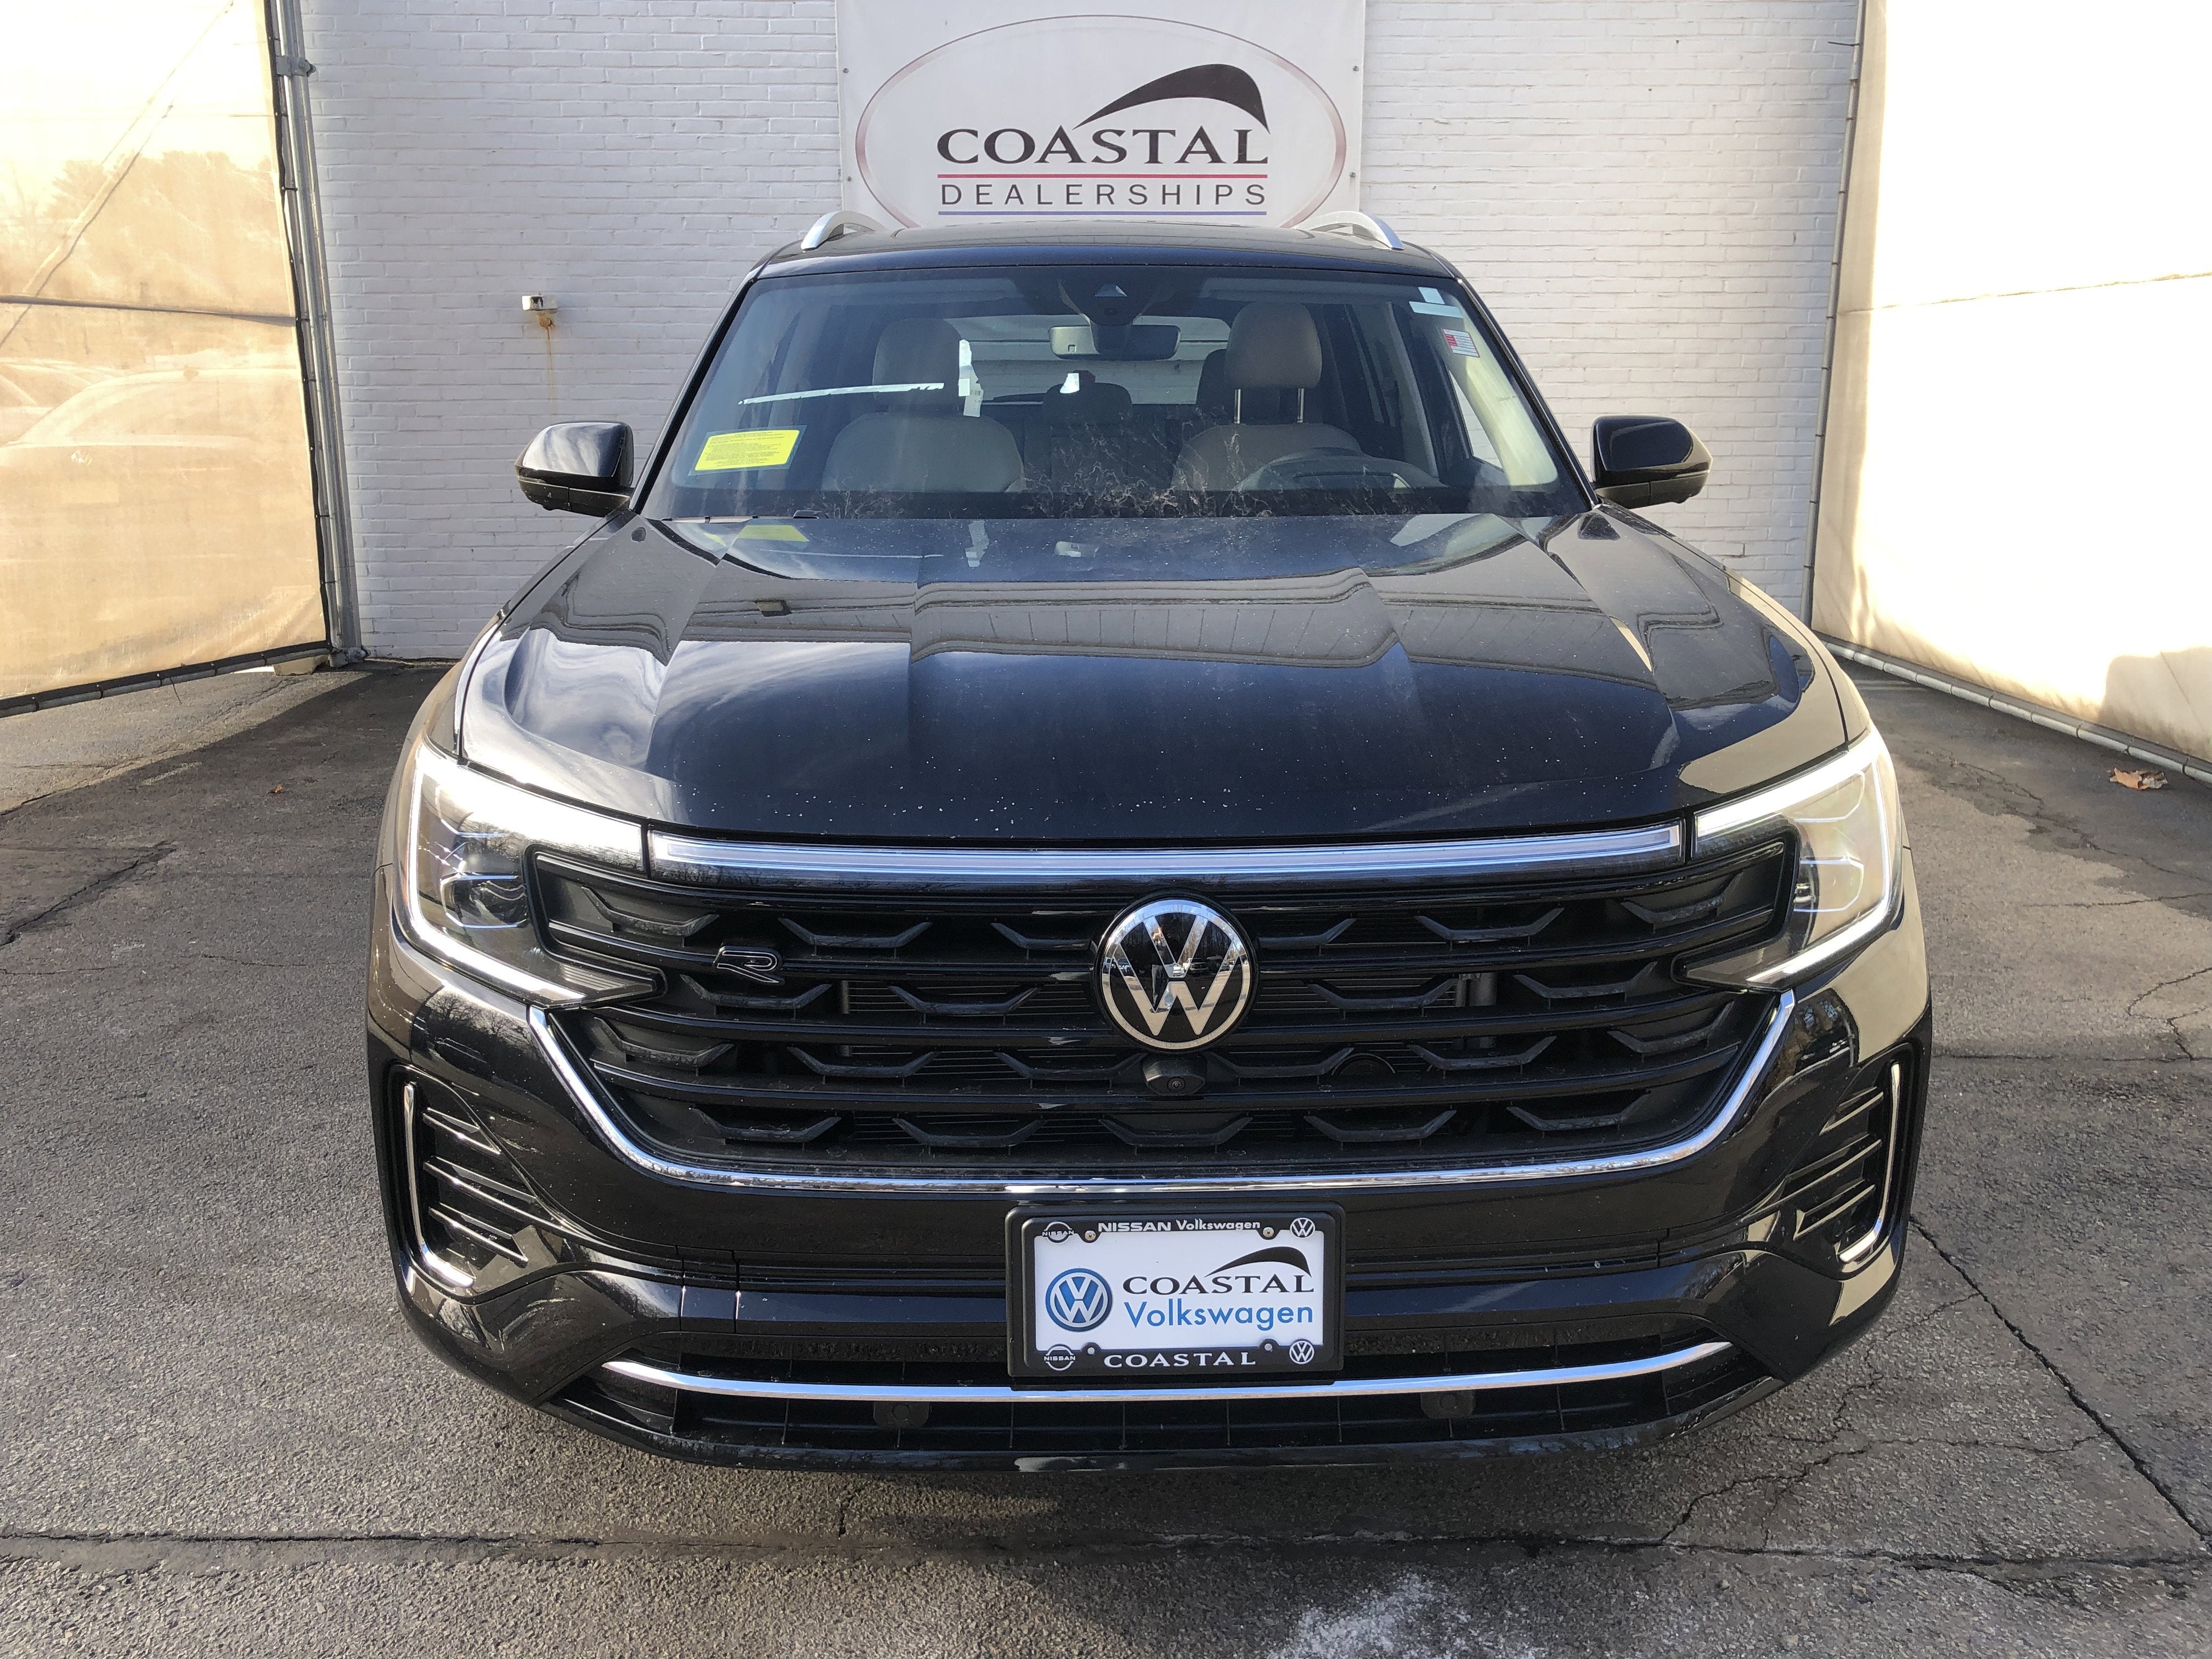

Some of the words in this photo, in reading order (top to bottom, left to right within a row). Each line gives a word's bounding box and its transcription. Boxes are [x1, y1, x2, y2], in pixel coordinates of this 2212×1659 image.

[936, 124, 1269, 165] COASTAL
[941, 184, 1266, 205] DEALERSHIPS
[1098, 1222, 1171, 1232] NISSAN
[1176, 1218, 1261, 1231] Volkswagen
[1122, 1274, 1314, 1295] COASTAL
[1124, 1298, 1313, 1331] Volkswagen
[1104, 1351, 1256, 1368] COASTAL
